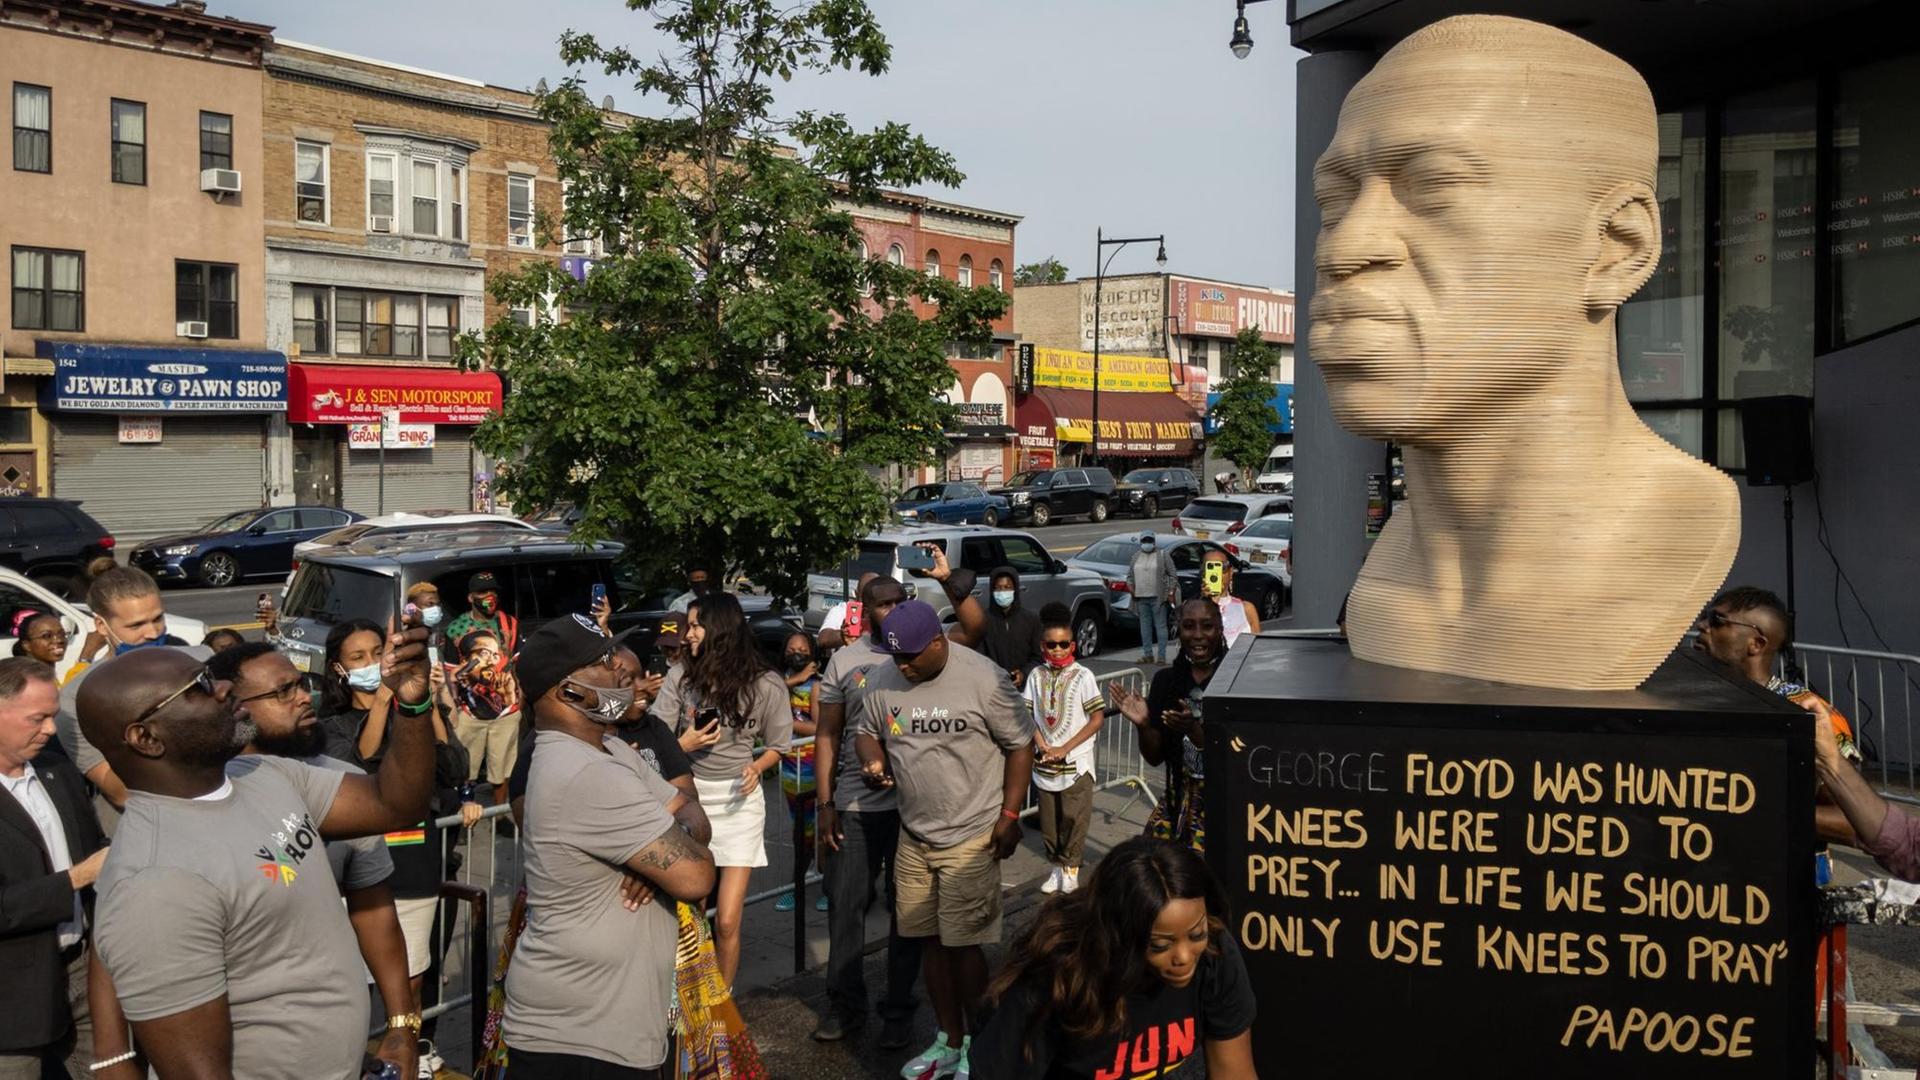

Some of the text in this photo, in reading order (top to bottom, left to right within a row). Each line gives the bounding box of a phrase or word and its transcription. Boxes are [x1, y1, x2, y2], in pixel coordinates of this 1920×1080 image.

[1129, 288, 1160, 305] CITY
[1238, 297, 1295, 335] FURNIT
[59, 359, 77, 368] 1542
[64, 375, 158, 396] JEWELRY
[179, 379, 233, 398] PAWN
[236, 380, 282, 398] SHOP
[61, 400, 160, 409] WE BUY GOLD AND DIAMOND
[345, 388, 493, 405] J & SEN MOTORSPORT
[960, 403, 1003, 413] OMPLETE
[351, 431, 380, 442] GRAN
[1028, 425, 1047, 436] FRUIT
[1098, 421, 1122, 439] BEST
[1125, 422, 1153, 440] FRUIT
[1155, 423, 1191, 440] MARKET
[1020, 436, 1055, 447] VEGETABLE
[912, 707, 949, 718] We Are
[912, 718, 968, 733] FLOYD
[1406, 753, 1515, 800] FLOYD
[1533, 760, 1604, 805] WAS
[1615, 761, 1756, 814] HUNTED
[1247, 803, 1714, 862] KNEES WERE USED TO
[1380, 863, 1416, 900] IN
[1439, 864, 1523, 911] LIFE
[1546, 869, 1606, 914] WE
[1620, 872, 1771, 926] SHOULD
[1241, 911, 1342, 959] ONLY
[1369, 918, 1446, 967] USE
[1477, 924, 1611, 977] KNEES
[1620, 933, 1668, 979] TO
[1560, 1004, 1756, 1058] PAPOOSE
